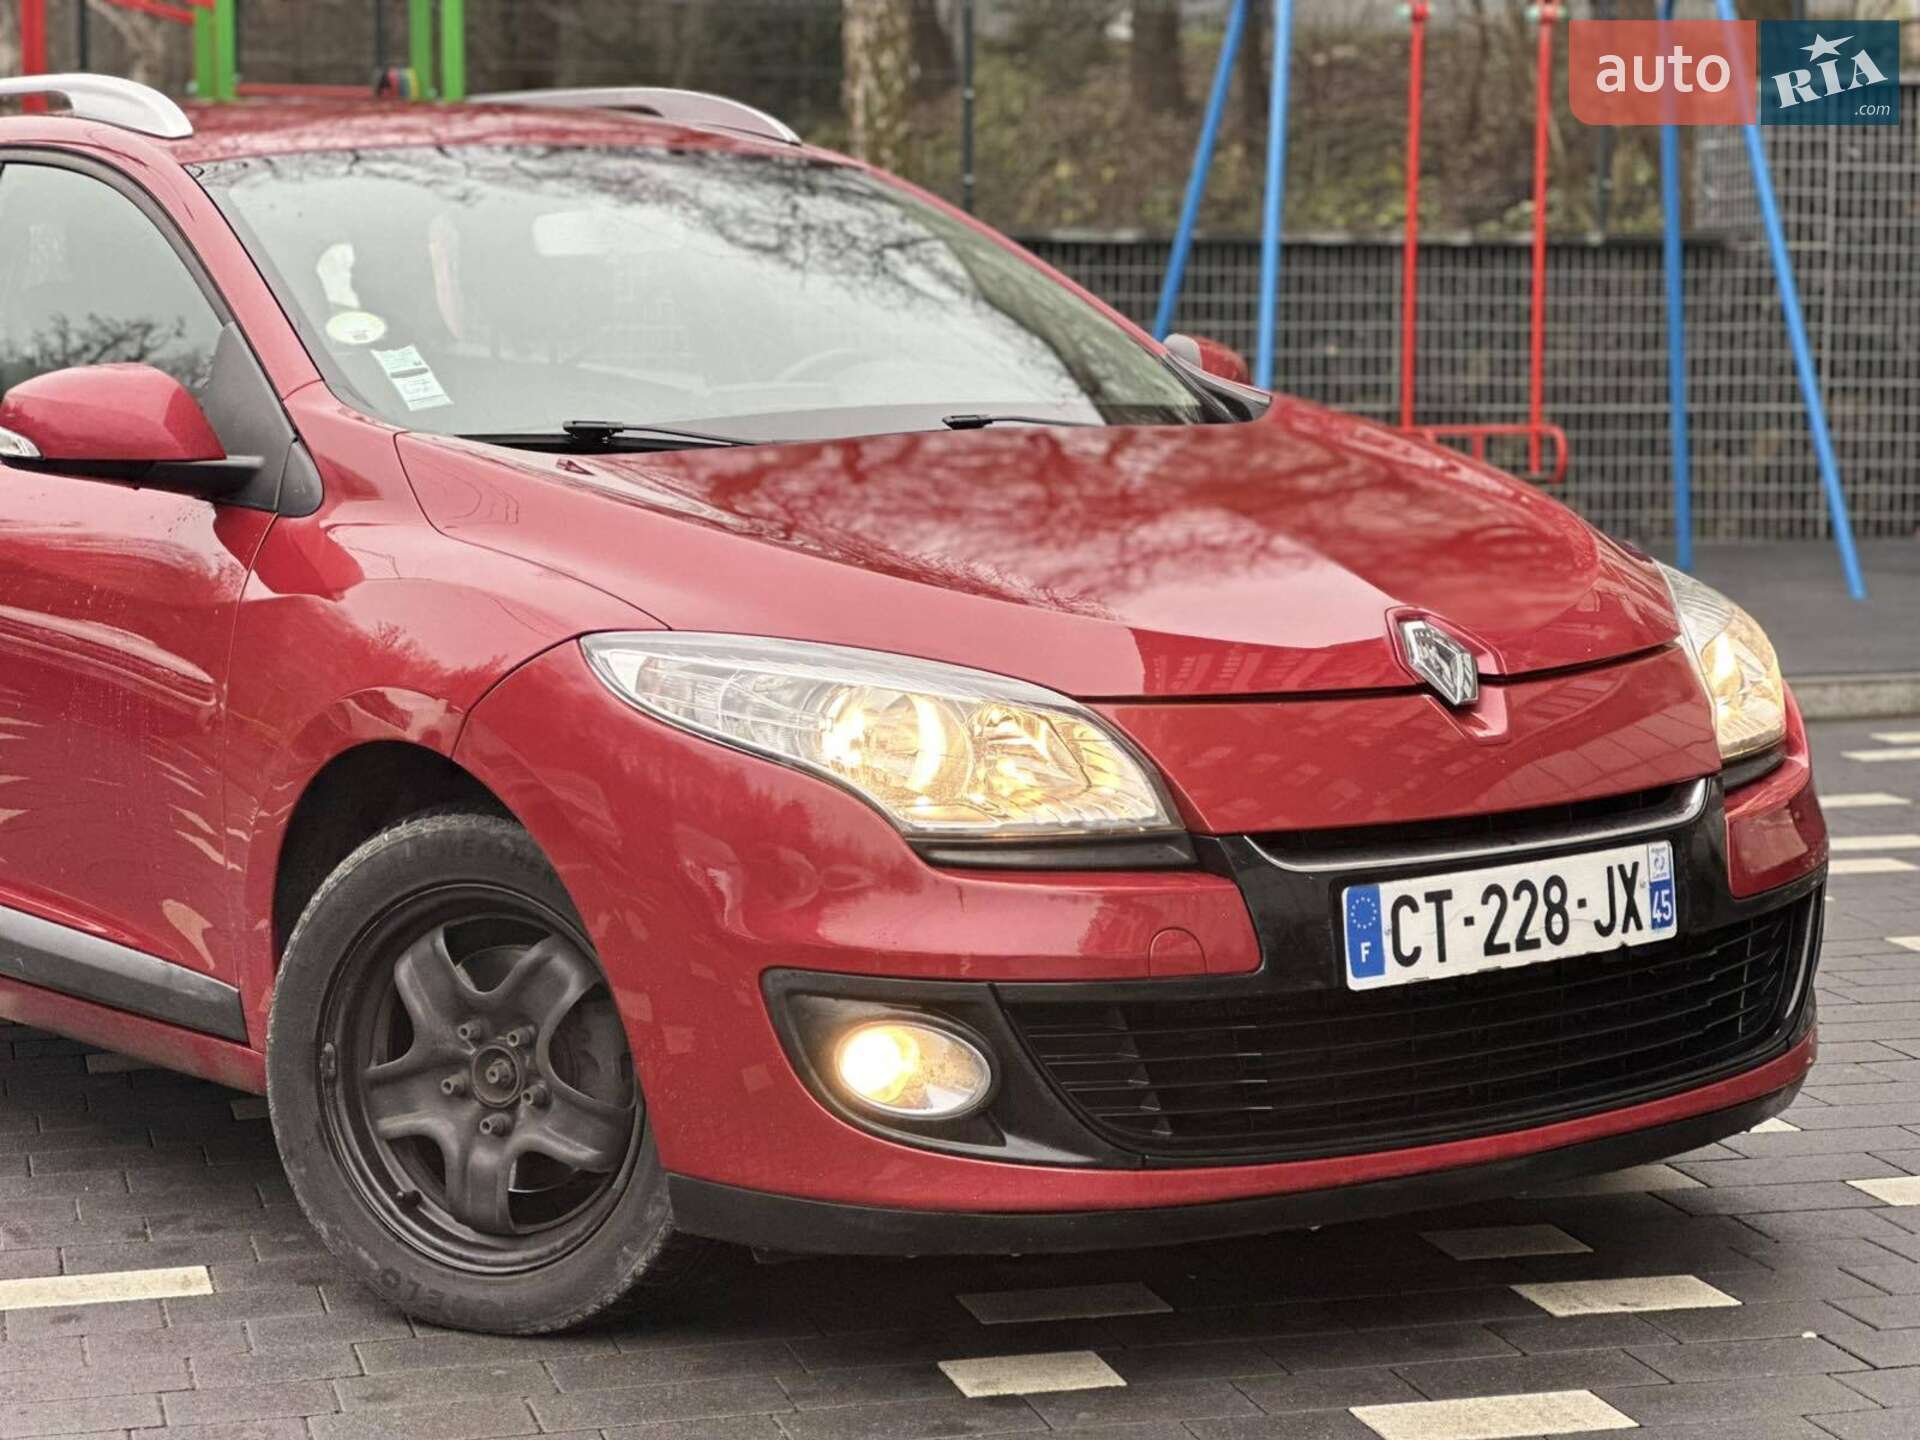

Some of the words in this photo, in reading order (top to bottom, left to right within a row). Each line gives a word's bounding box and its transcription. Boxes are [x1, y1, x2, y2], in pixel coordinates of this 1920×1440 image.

[1390, 861, 1644, 968] CT-228-JX
[1652, 888, 1672, 922] 45
[1360, 941, 1371, 963] F
